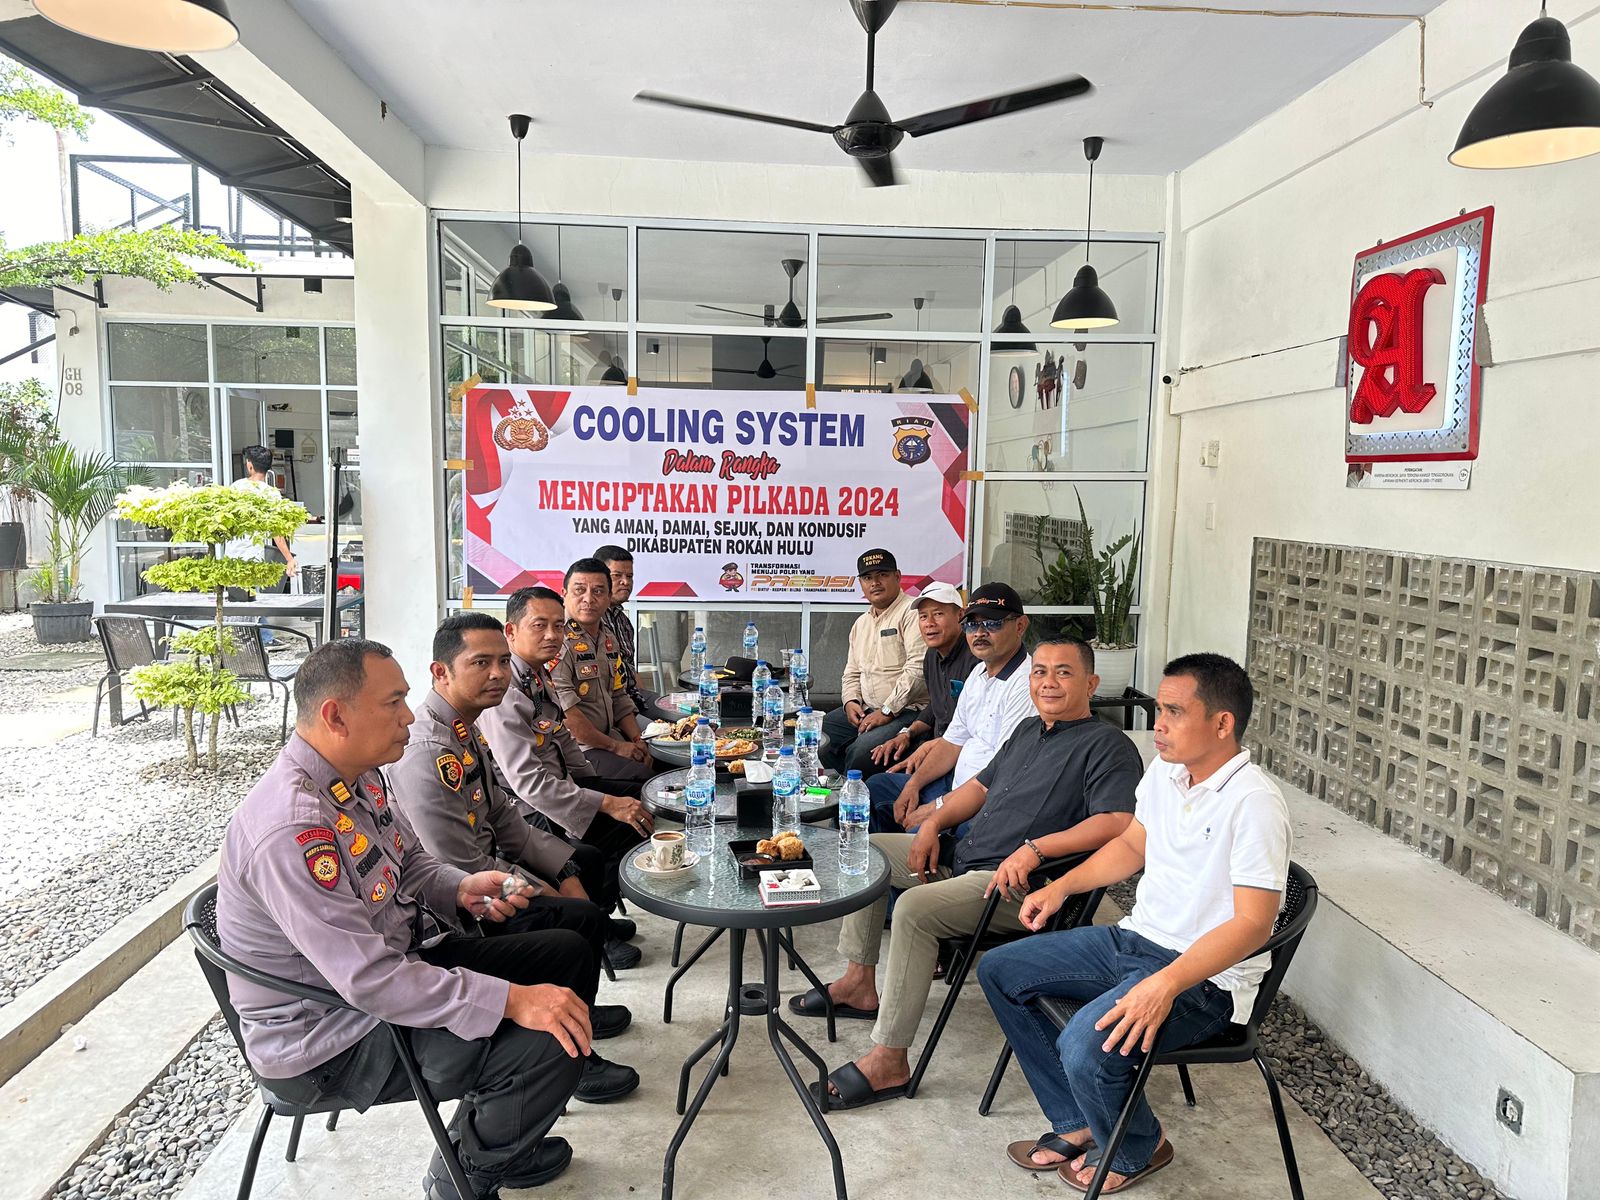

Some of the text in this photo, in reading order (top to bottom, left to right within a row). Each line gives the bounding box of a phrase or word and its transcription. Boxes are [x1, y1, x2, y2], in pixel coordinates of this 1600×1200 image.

[65, 368, 81, 380] GH
[65, 382, 82, 396] 08
[573, 405, 865, 447] COOLING SYSTEM
[662, 449, 781, 480] Dalam Rangka
[538, 480, 899, 517] MENCIPTAKAN PILKADA 2024
[572, 518, 867, 539] YANG AMAN, DAMAI, SEJUK, DAN KONDUSIF
[627, 538, 814, 556] DIKABUPATEN ROKAN HULU
[751, 575, 856, 587] PRESISI
